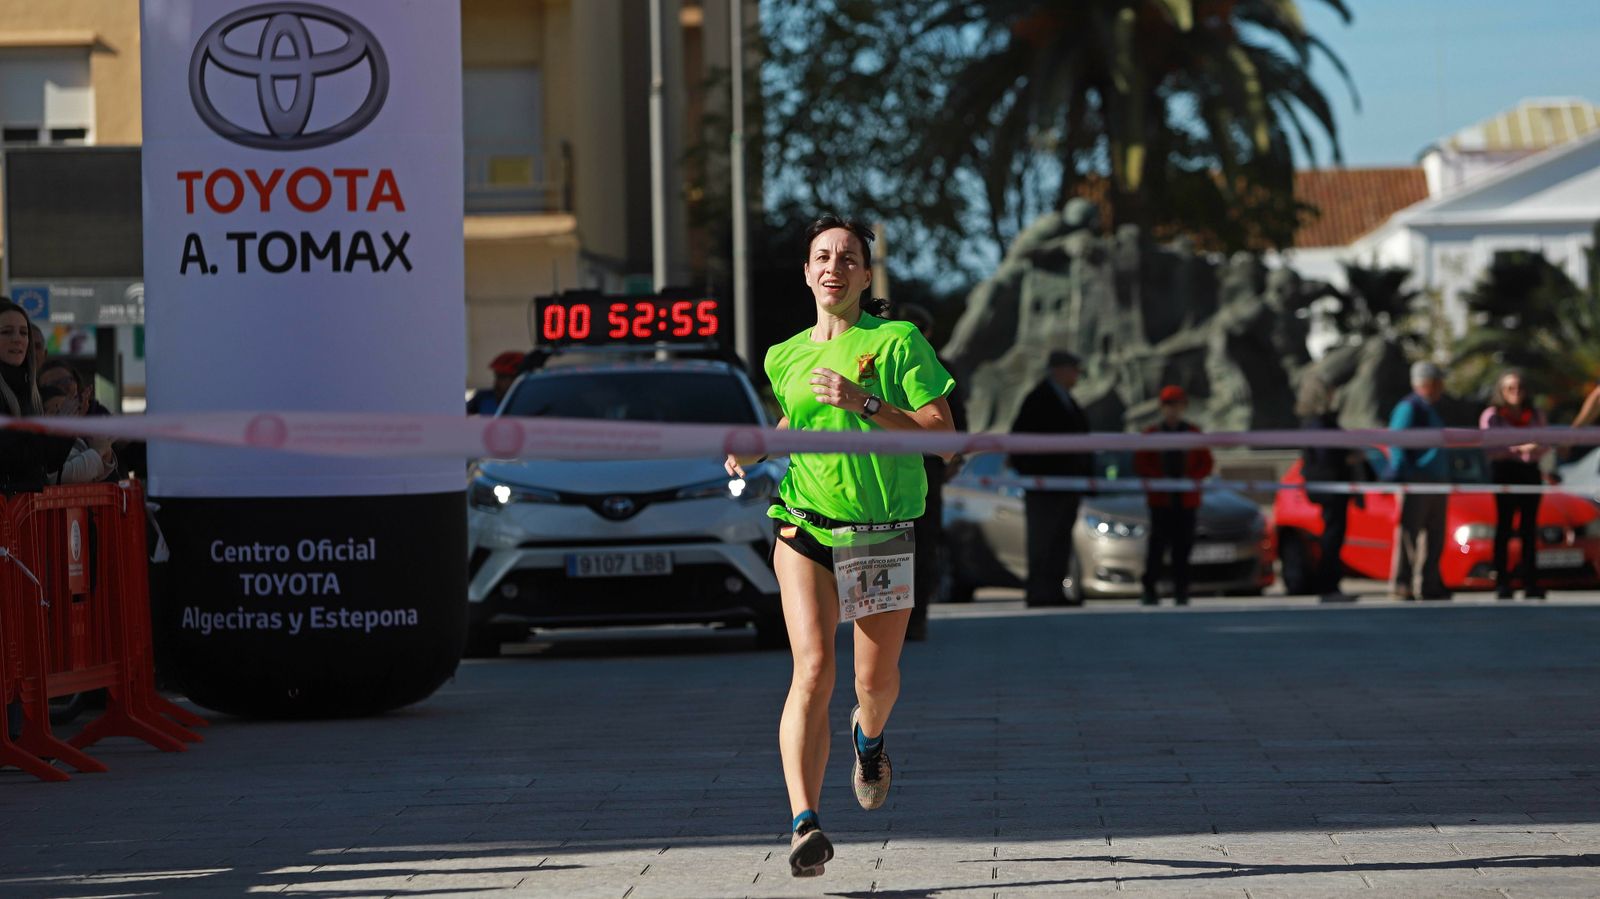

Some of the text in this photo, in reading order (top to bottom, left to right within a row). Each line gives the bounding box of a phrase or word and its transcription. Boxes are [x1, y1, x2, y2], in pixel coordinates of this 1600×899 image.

[177, 167, 405, 214] TOYOTA
[180, 230, 413, 275] A. TOMAX
[543, 300, 718, 340] 00 52:55
[210, 538, 376, 562] Centro Oficial
[580, 555, 626, 573] 9107
[240, 572, 340, 596] TOYOTA
[857, 569, 891, 593] 14
[182, 606, 418, 635] Algeciras y Estepona
